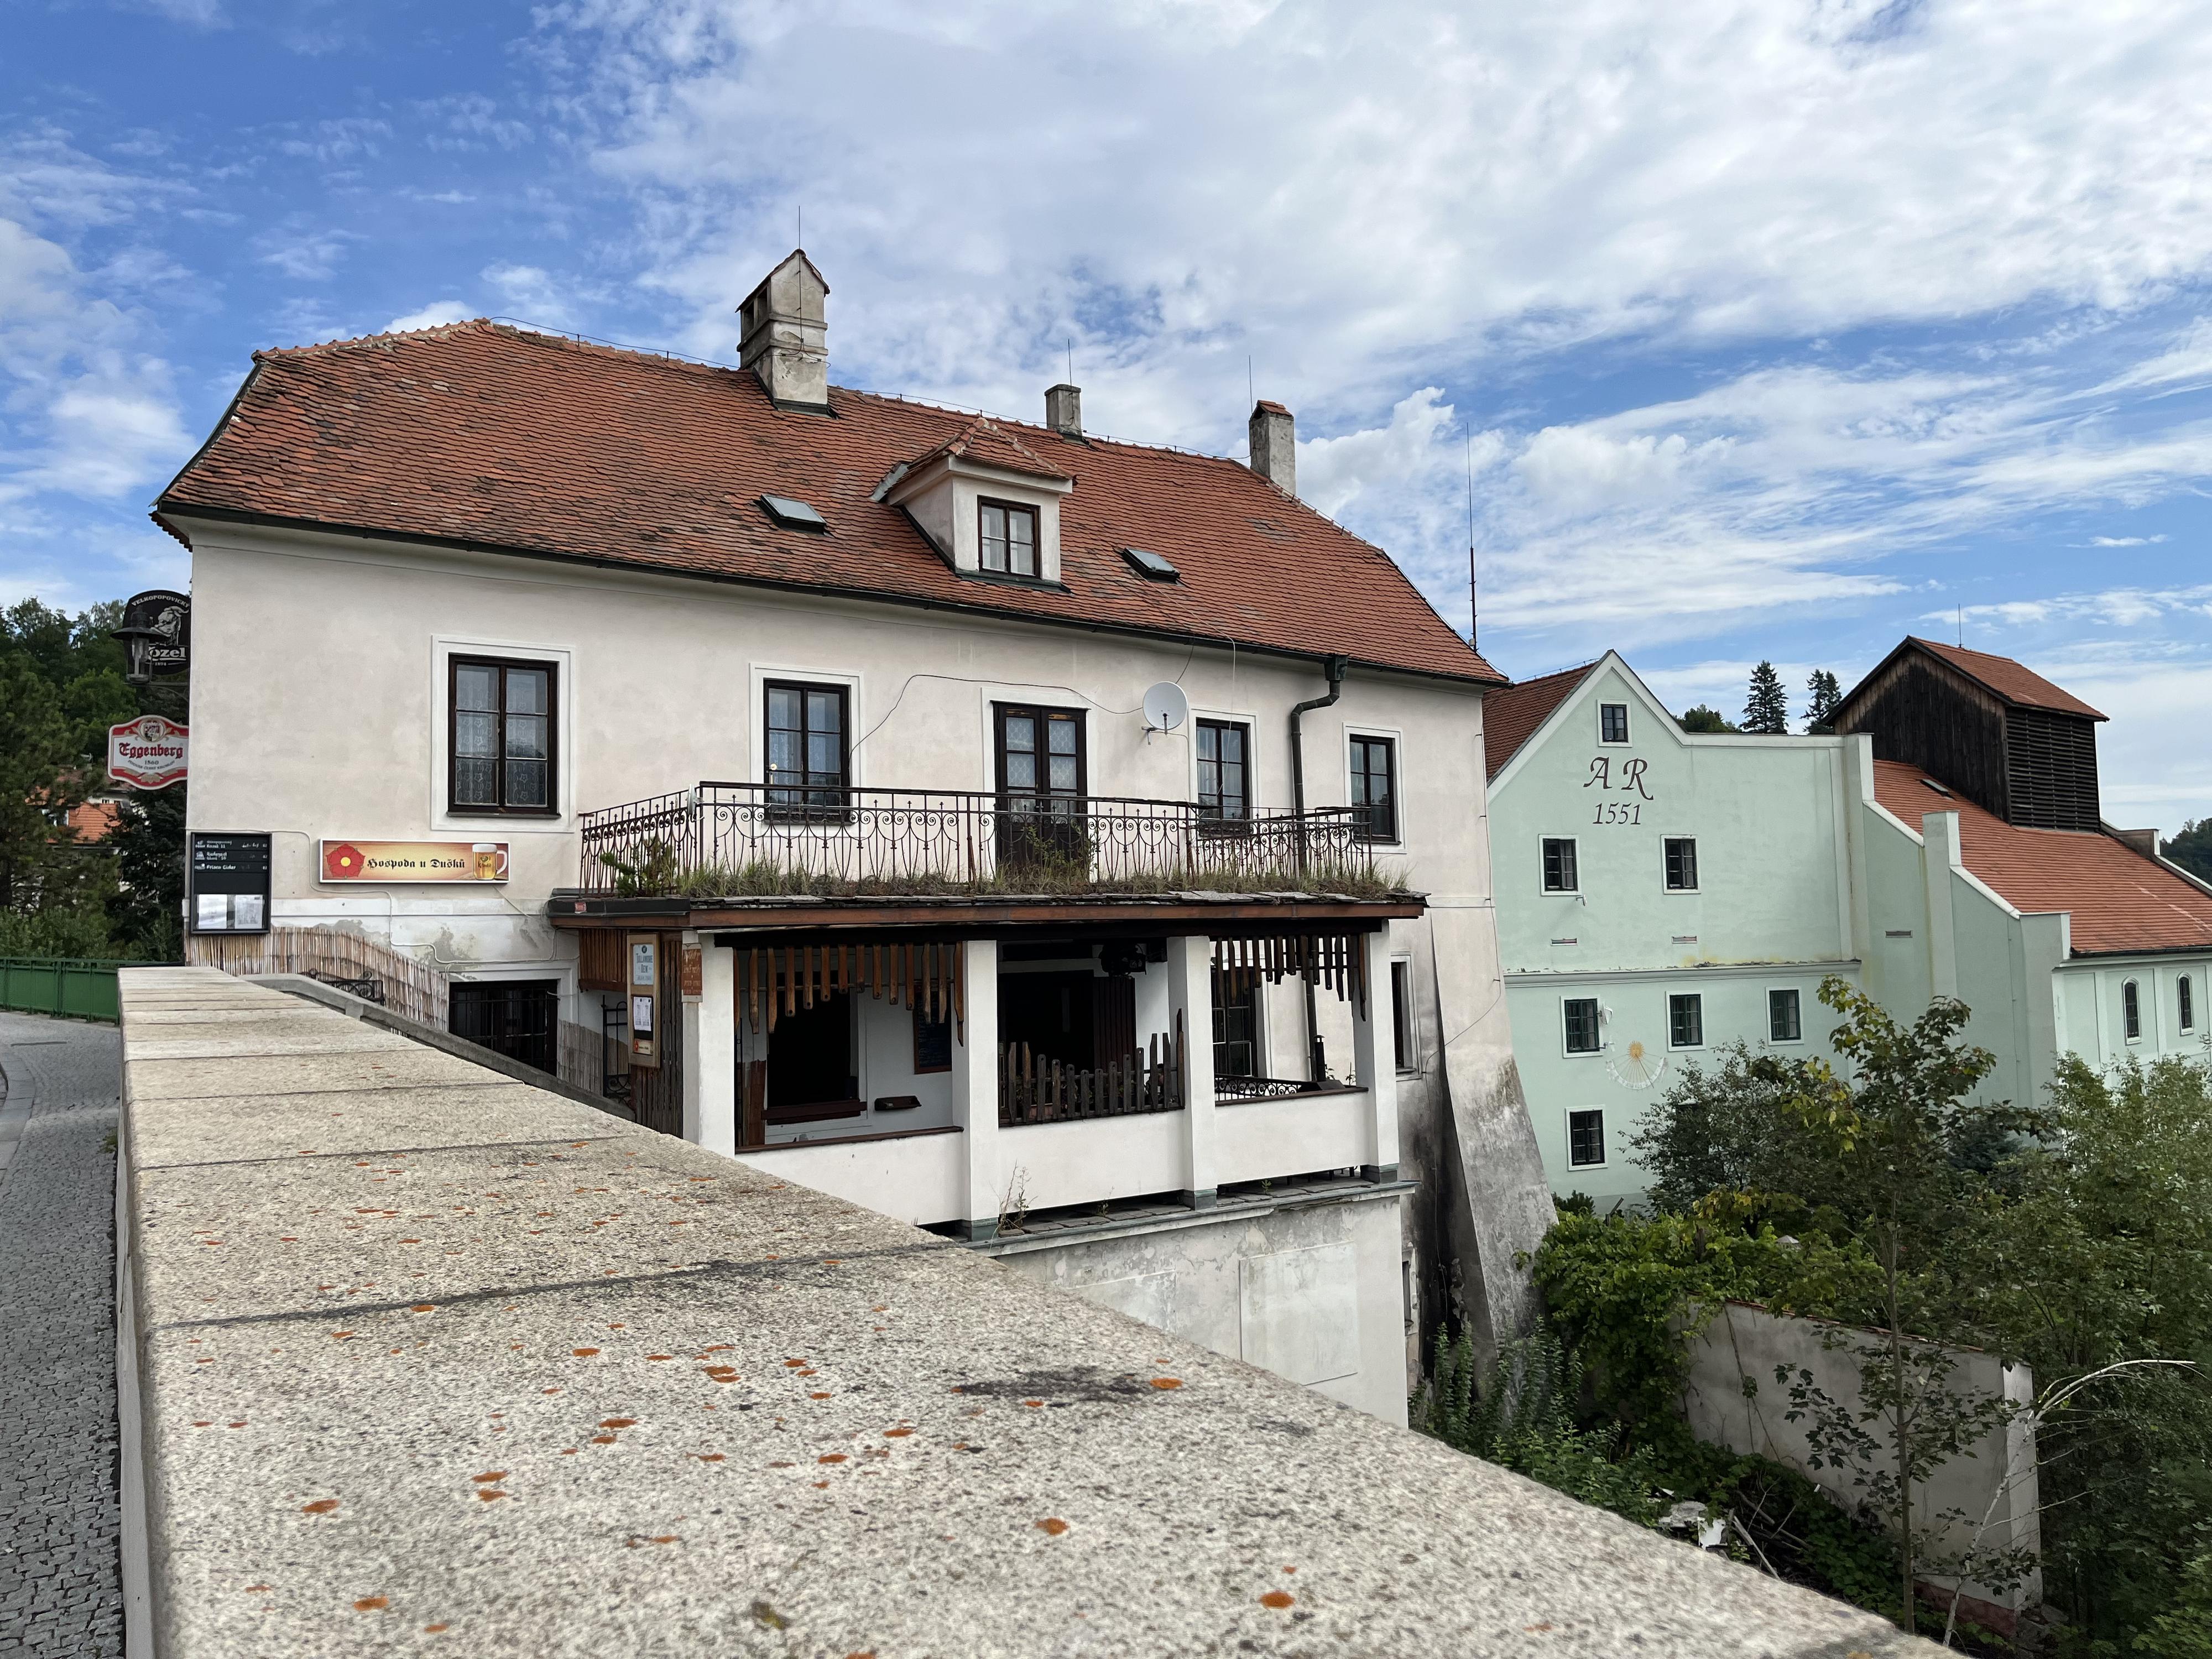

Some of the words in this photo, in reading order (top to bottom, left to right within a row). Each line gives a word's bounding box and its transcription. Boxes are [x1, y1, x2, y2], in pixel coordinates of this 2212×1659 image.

[119, 742, 183, 759] Eggenberg
[1583, 757, 1613, 789] A
[1621, 758, 1653, 800] R
[1593, 802, 1641, 825] 1551
[367, 858, 415, 870] Hospoda
[430, 859, 465, 868] Dušků
